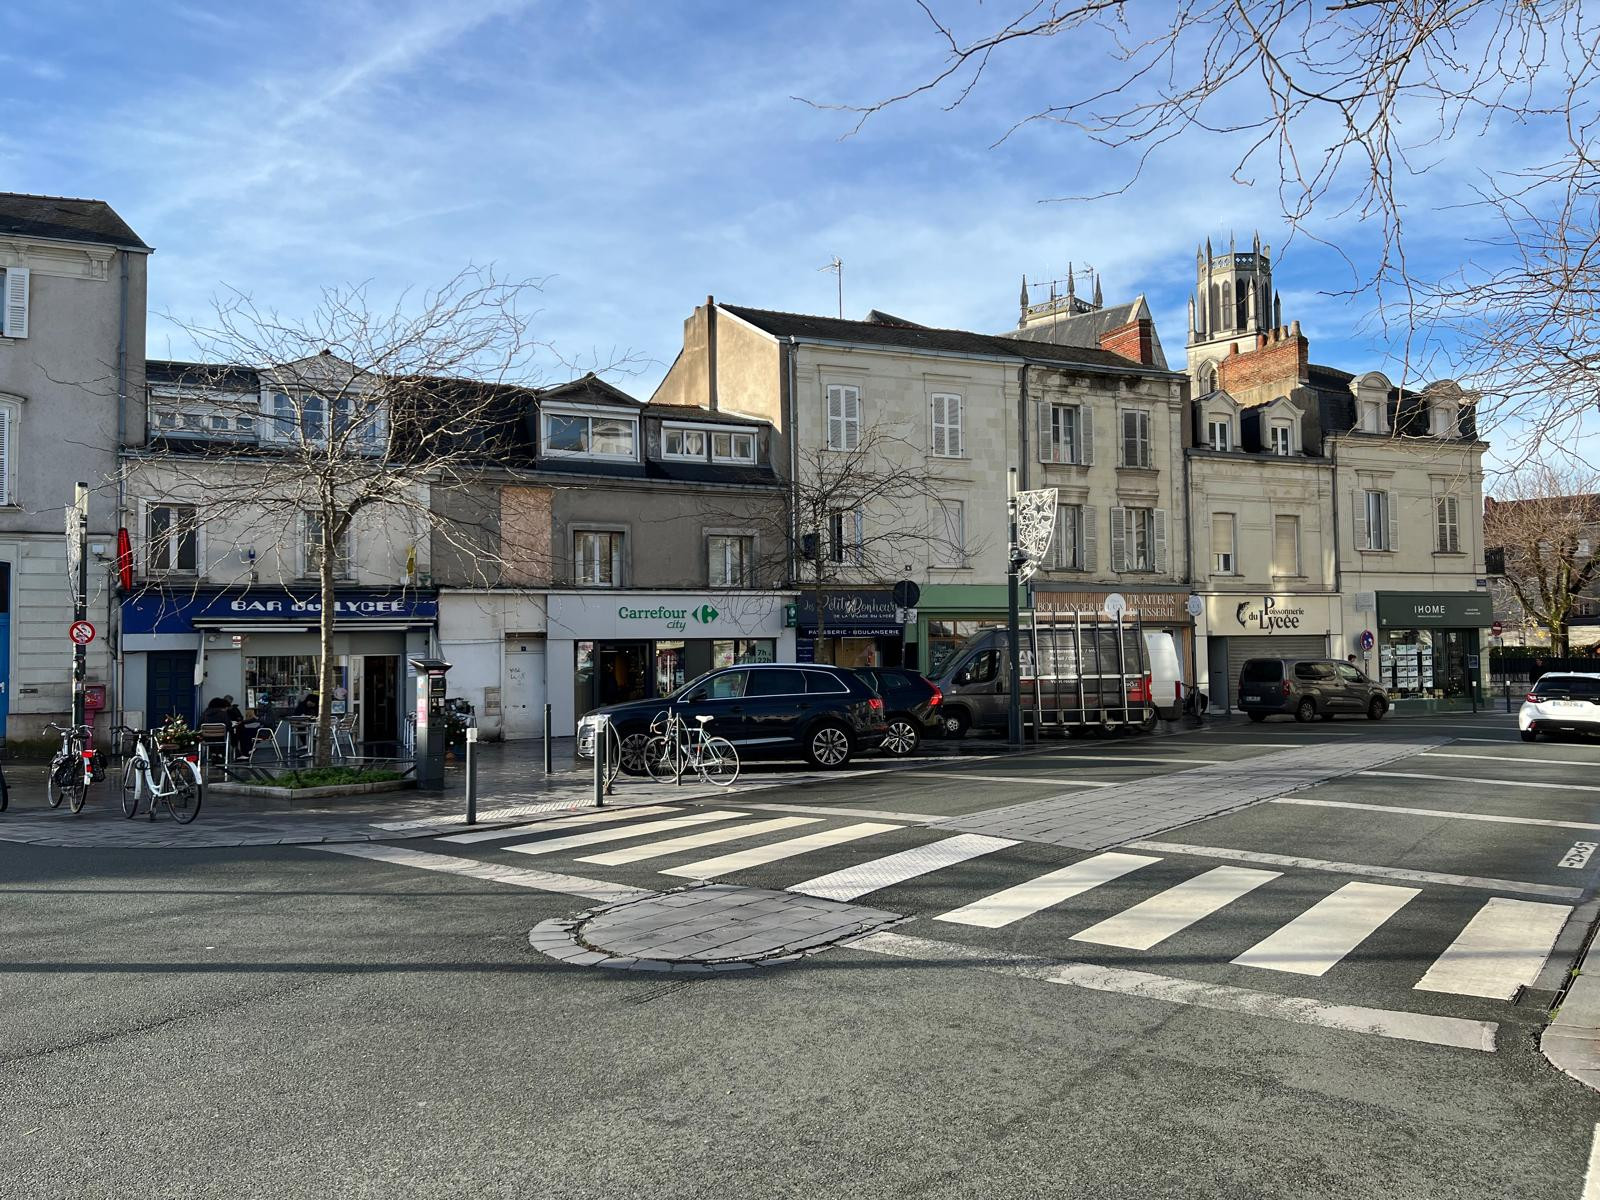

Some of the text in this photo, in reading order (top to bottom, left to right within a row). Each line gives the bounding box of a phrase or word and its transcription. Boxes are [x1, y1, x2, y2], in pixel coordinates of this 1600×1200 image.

[1128, 594, 1175, 605] TRAITEUR
[231, 601, 282, 611] BAR
[1037, 602, 1104, 612] BOULANGERIE
[1264, 596, 1304, 615] Poissonnerie
[1414, 605, 1446, 614] IHOME
[618, 606, 687, 619] Carrefour
[1129, 608, 1175, 616] PTISSERIE
[666, 620, 687, 632] city
[1249, 610, 1300, 634] du Lycée
